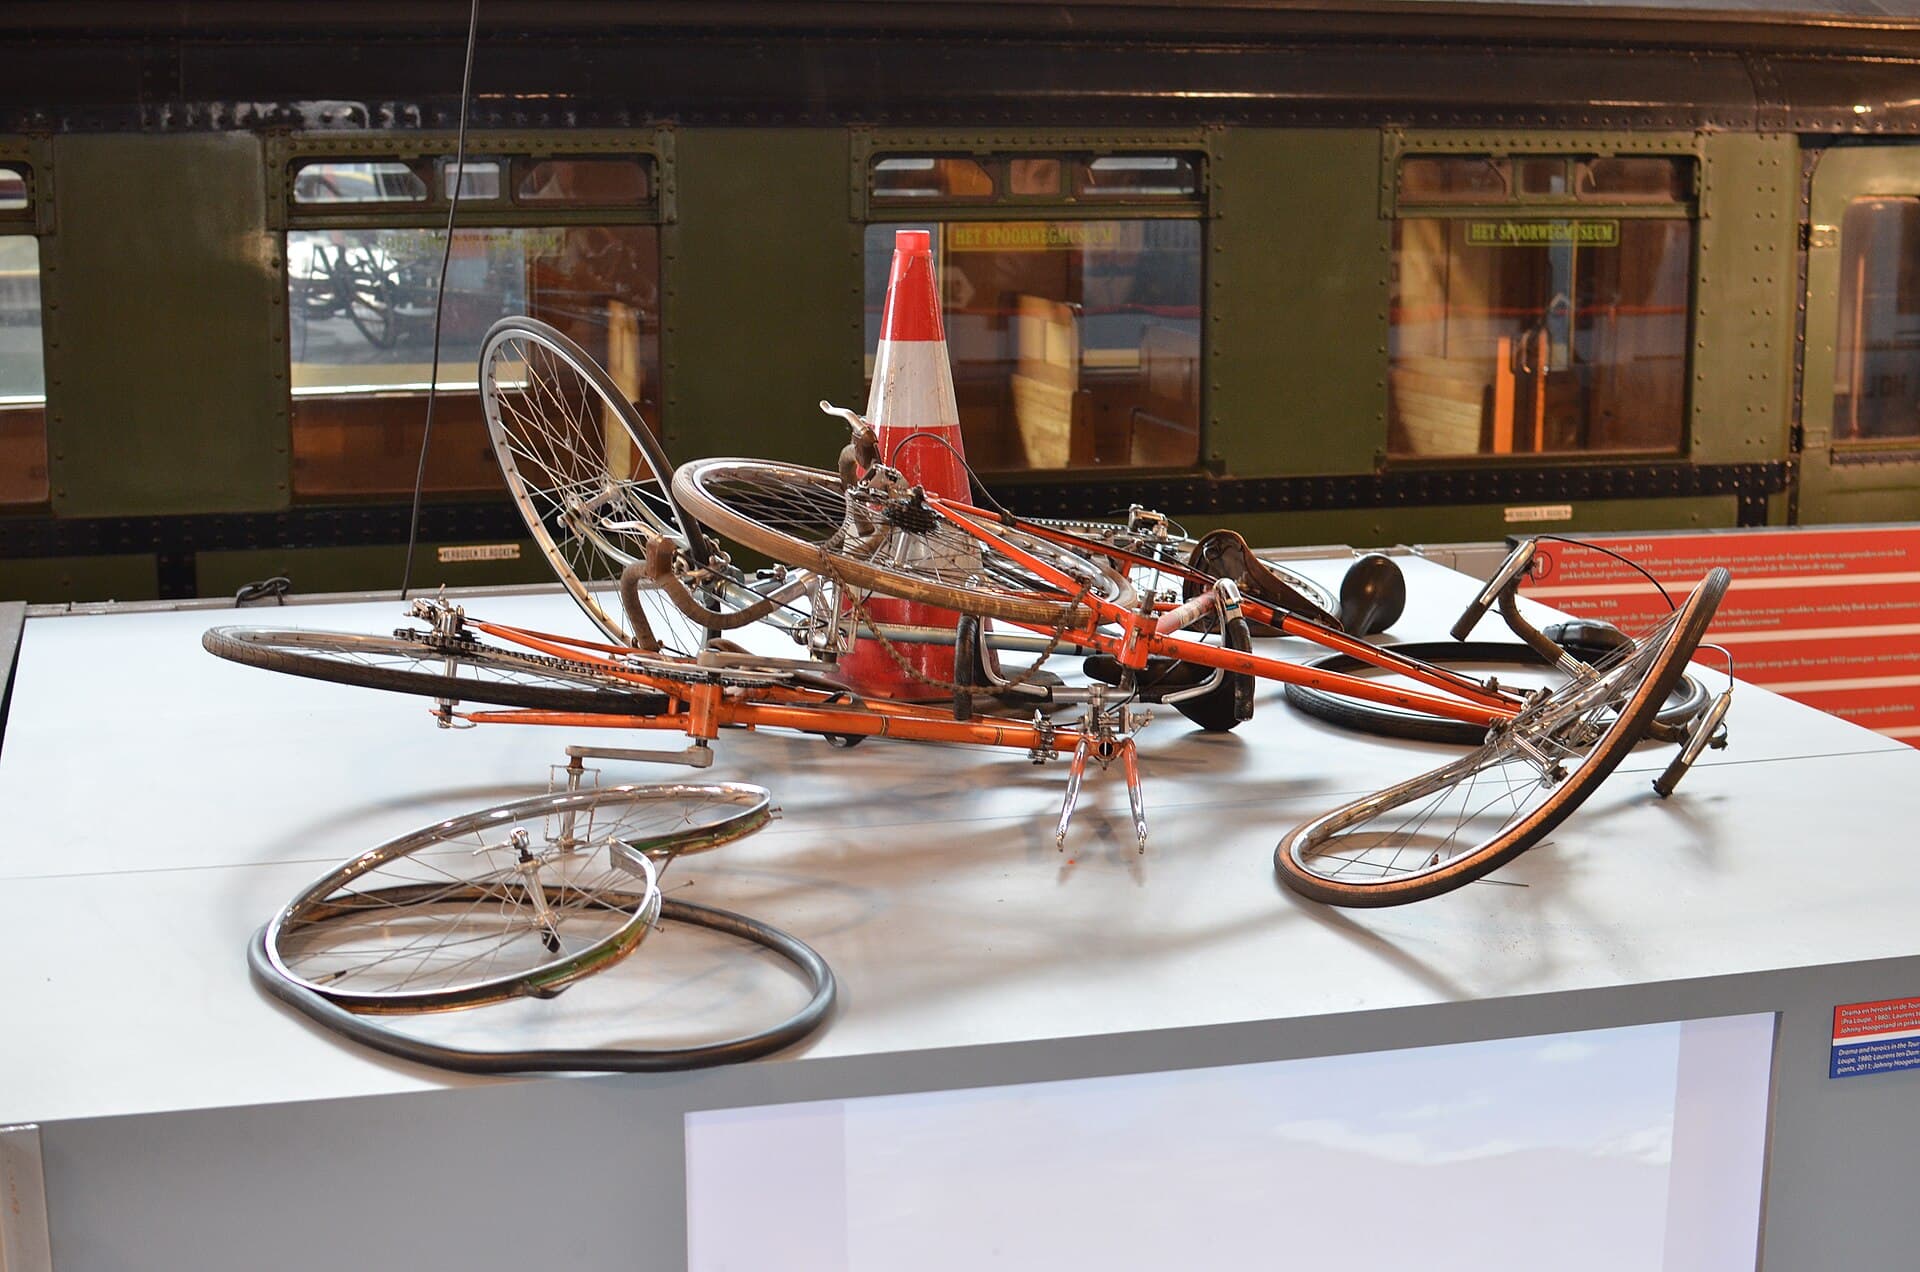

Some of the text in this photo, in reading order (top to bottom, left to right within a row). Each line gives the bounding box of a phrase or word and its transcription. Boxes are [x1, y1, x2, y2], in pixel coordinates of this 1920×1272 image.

[956, 228, 980, 245] HET
[1472, 223, 1496, 240] HET
[1536, 557, 1544, 574] 1
